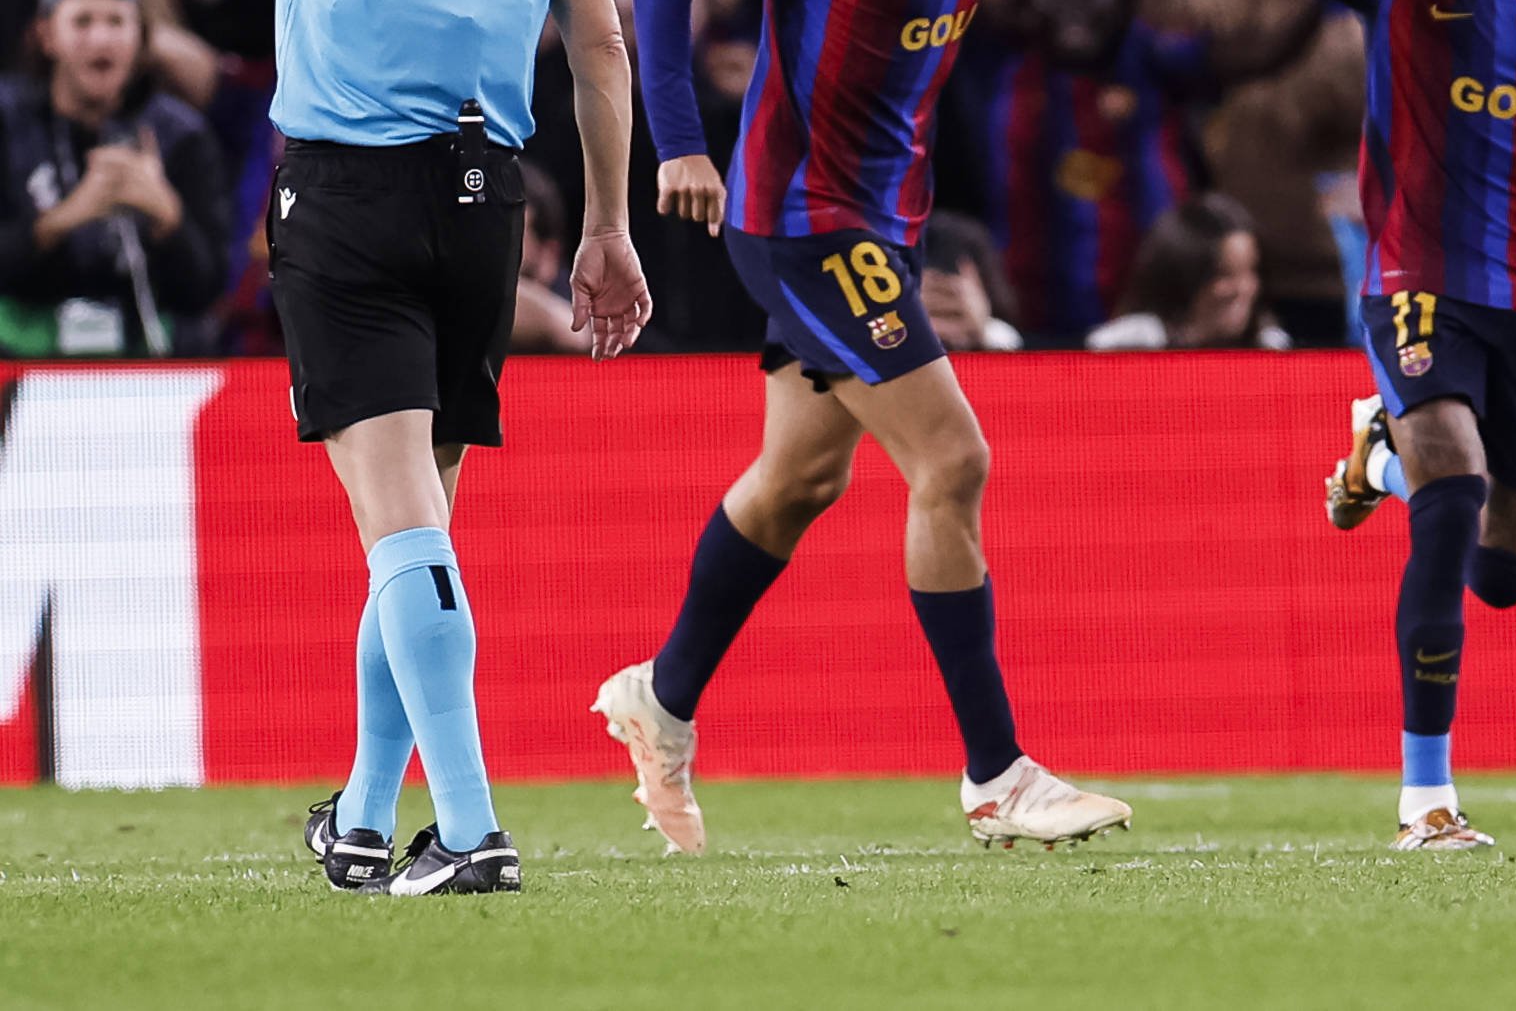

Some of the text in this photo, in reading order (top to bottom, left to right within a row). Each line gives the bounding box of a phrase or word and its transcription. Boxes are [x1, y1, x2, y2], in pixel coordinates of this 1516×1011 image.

[900, 1, 979, 51] GOL
[821, 240, 902, 318] 18
[1391, 290, 1437, 348] 11
[346, 864, 375, 878] NIKE
